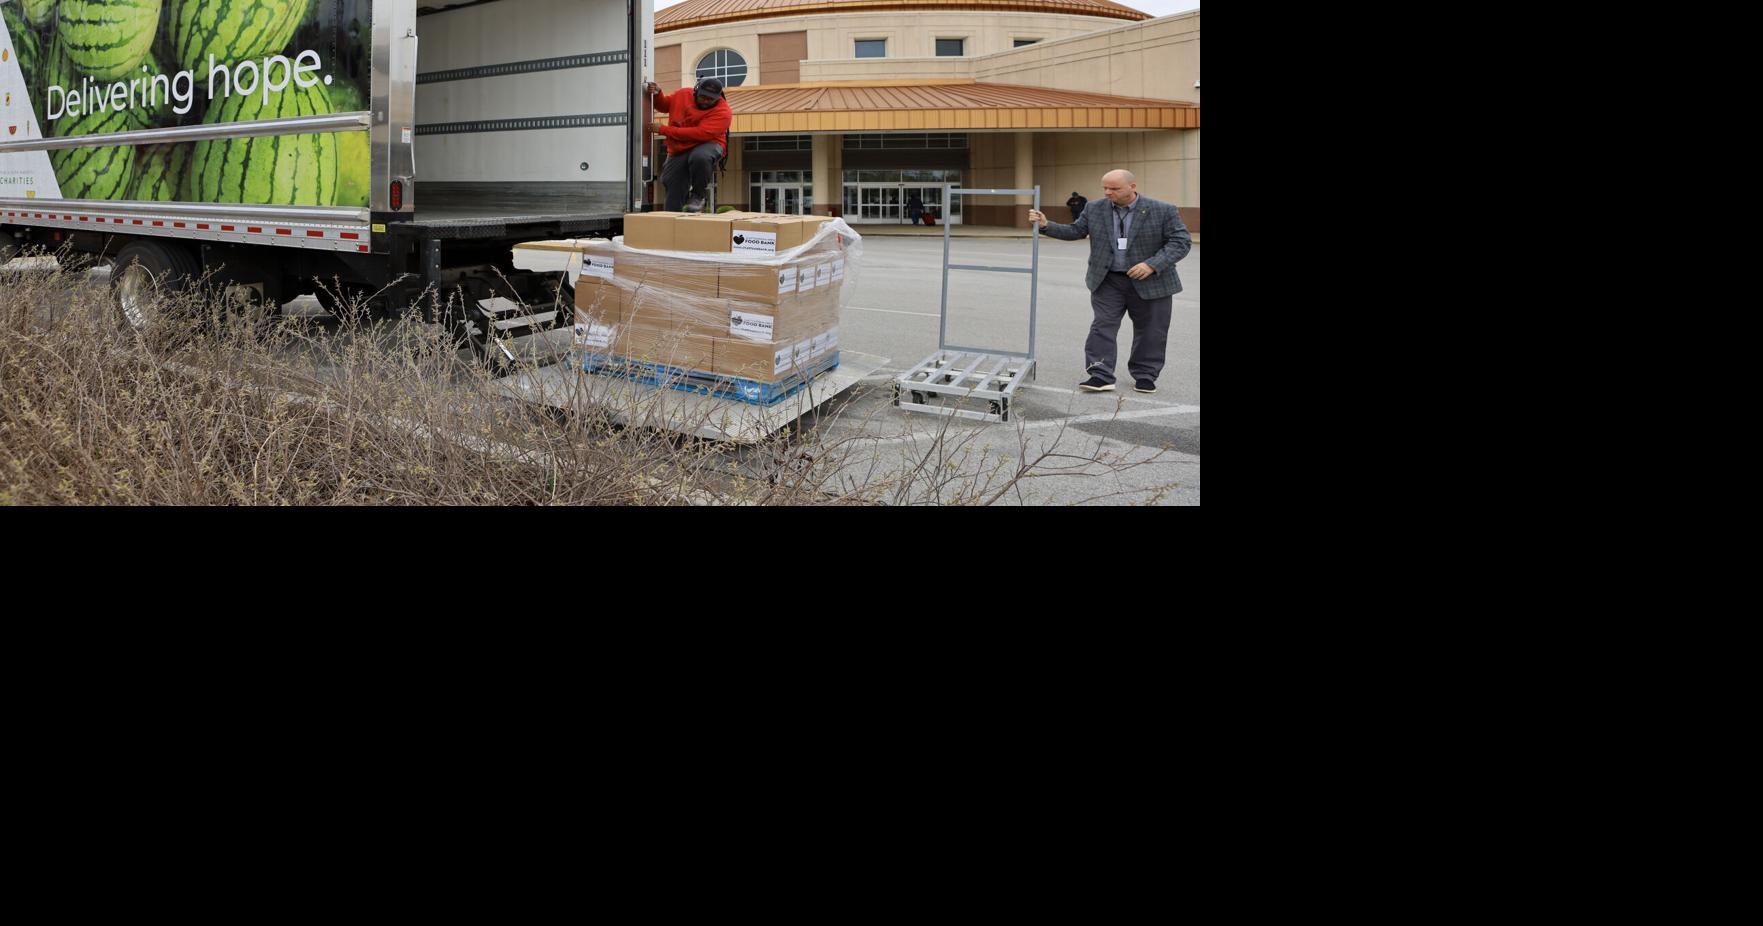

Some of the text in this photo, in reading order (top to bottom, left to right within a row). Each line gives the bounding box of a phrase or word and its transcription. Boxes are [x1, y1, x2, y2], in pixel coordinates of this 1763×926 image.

[47, 49, 333, 120] Delivering hope.
[0, 176, 34, 185] CHARITIES
